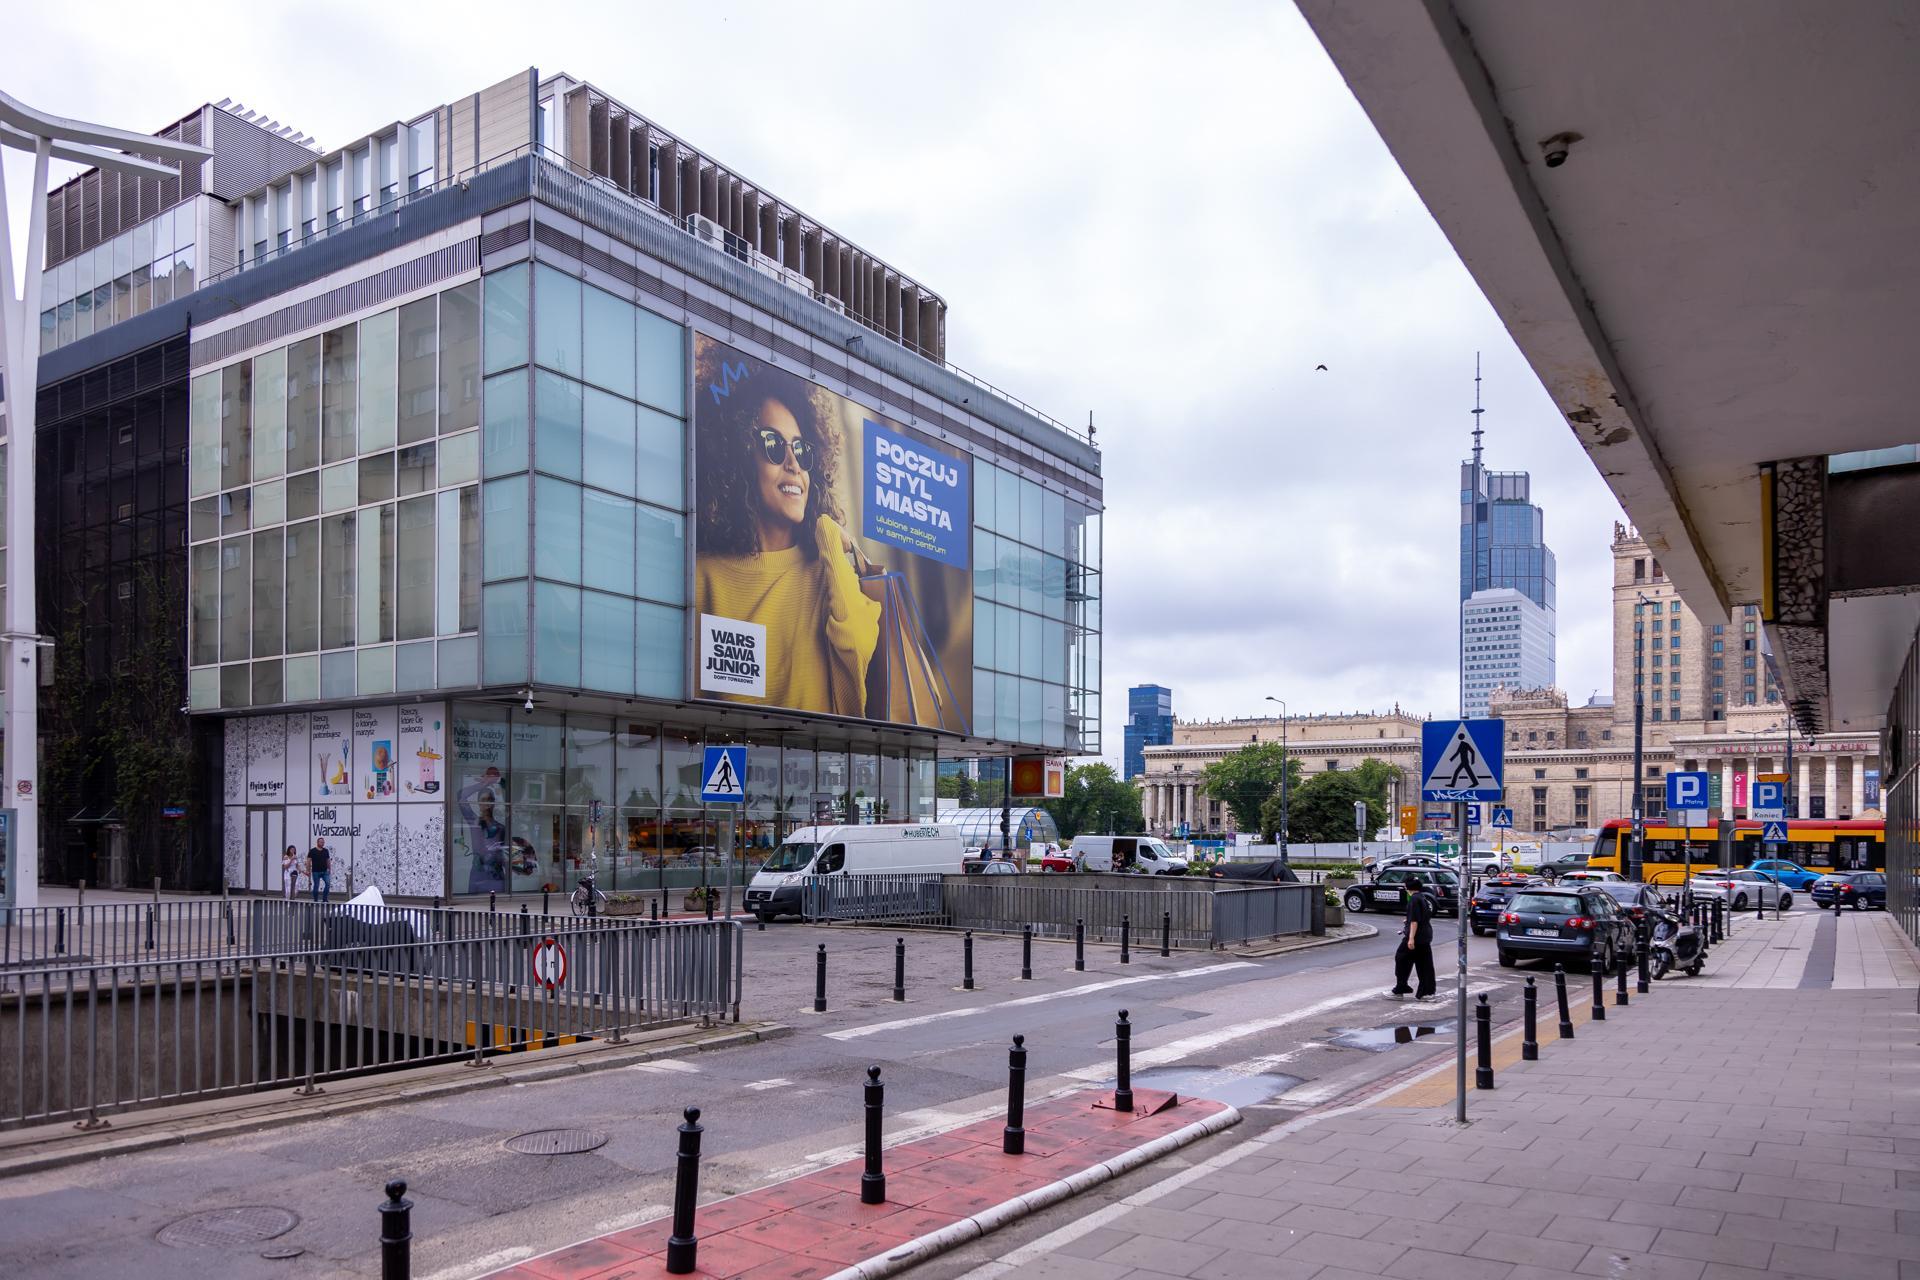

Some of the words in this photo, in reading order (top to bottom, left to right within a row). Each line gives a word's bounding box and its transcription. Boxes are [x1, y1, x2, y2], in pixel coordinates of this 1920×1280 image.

[876, 436, 958, 487] POCZUJ
[876, 462, 933, 501] STYL
[876, 485, 952, 532] MIASTA
[876, 515, 908, 532] ulubione
[910, 527, 936, 543] zakupy
[876, 526, 884, 535] w
[886, 529, 914, 544] samym
[915, 539, 946, 555] centrum
[711, 628, 755, 648] WARS
[713, 644, 755, 663] SAWA
[706, 657, 760, 677] JUNIOR
[453, 727, 478, 738] Niech
[480, 728, 505, 742] każdy
[250, 781, 267, 792] flying
[268, 781, 284, 791] tiger
[1676, 776, 1700, 805] P
[1759, 785, 1777, 805] P
[312, 823, 360, 836] Warszawa!
